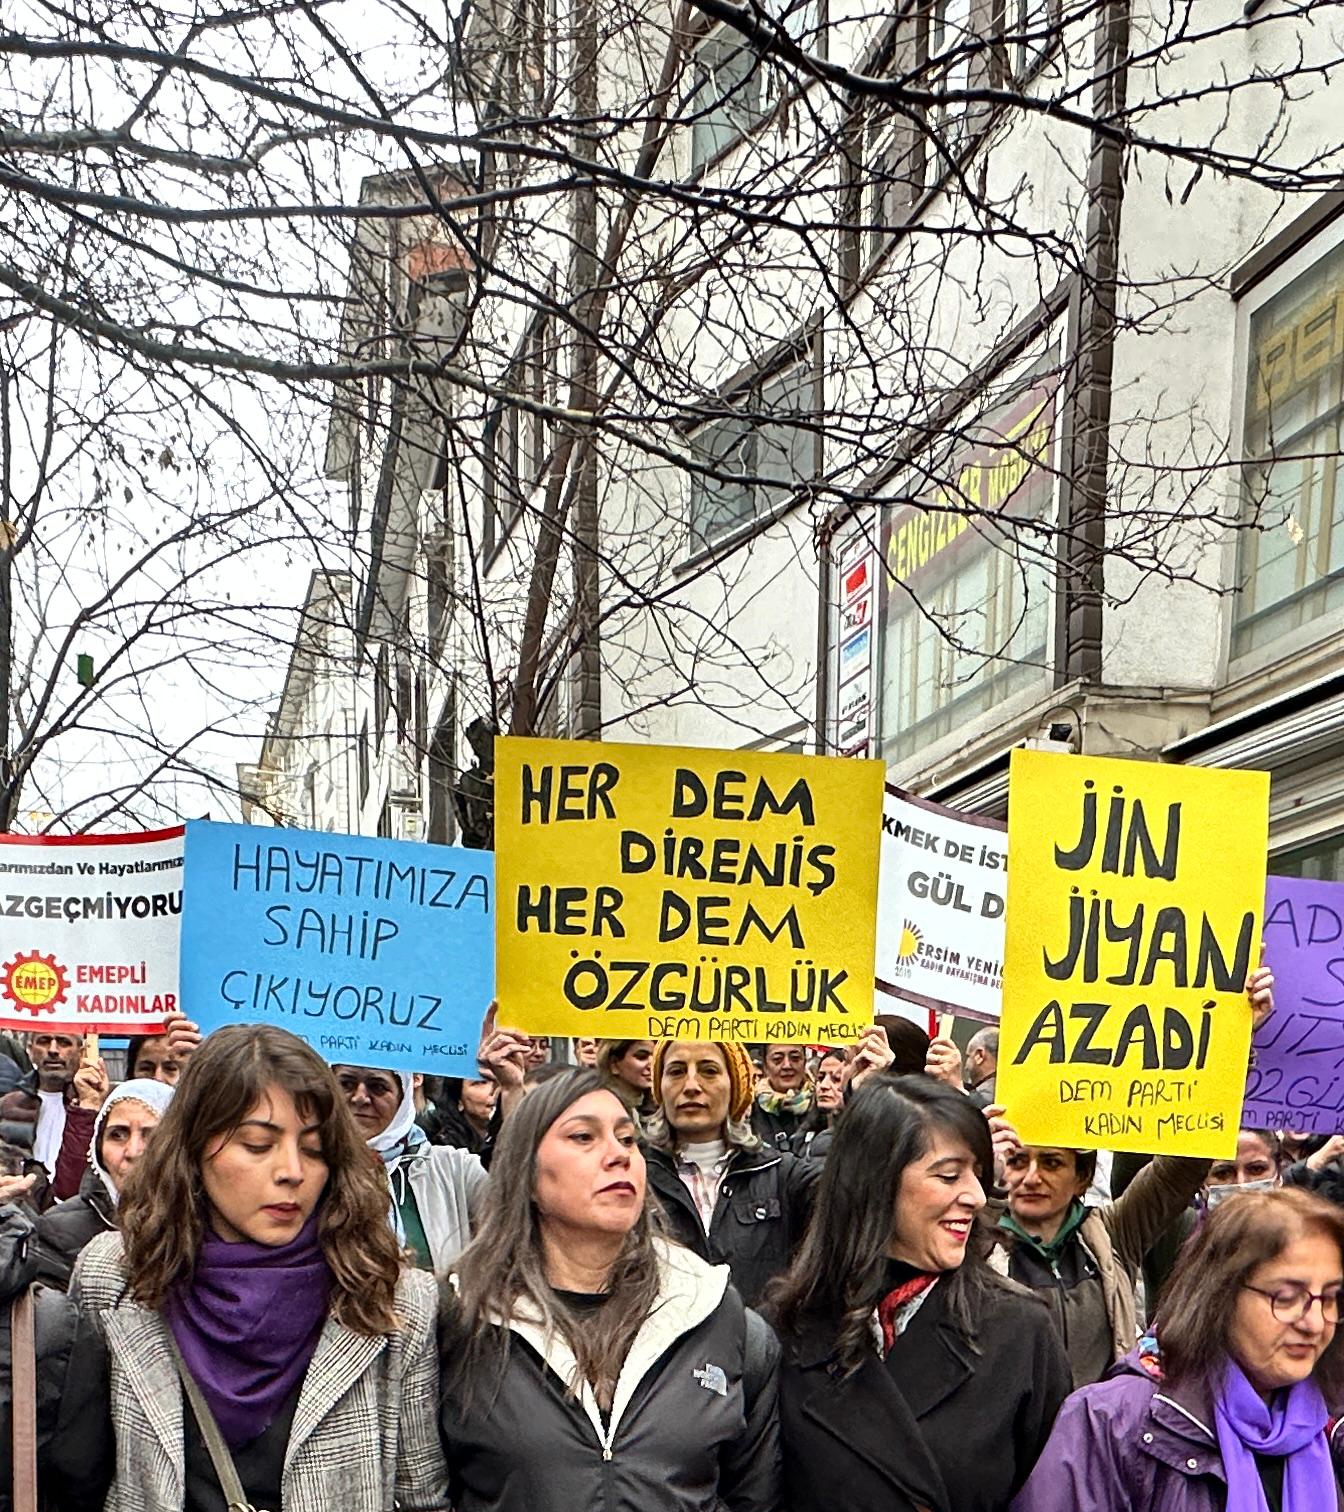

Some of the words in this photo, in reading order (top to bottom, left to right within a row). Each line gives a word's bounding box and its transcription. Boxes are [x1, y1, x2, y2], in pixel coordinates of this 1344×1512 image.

[522, 762, 620, 825] HER
[670, 768, 816, 826] DEM
[76, 862, 96, 875] Ve
[99, 855, 184, 877] Hayatlarımız
[621, 827, 836, 897] DİRENİŞ
[881, 813, 941, 853] KMEK
[944, 840, 975, 864] DE
[979, 845, 1008, 873] İST
[233, 843, 490, 914] HAYATIMIZA
[907, 871, 972, 913] GÜL
[980, 892, 1006, 919] D
[263, 904, 399, 961] SAHİP
[517, 884, 626, 938] HER
[658, 889, 806, 949] DEM
[14, 975, 57, 991] EMEP
[76, 961, 146, 984] EMEPLİ
[563, 949, 850, 1014] ÖZGÜRLÜK
[76, 993, 177, 1014] KADINLAR
[220, 970, 443, 1032] ÇIKIYORUZ
[369, 1039, 412, 1053] KADIN
[648, 1016, 701, 1039] DEM
[766, 1020, 811, 1041] KADIN
[1012, 999, 1217, 1071] AZADİ
[1058, 1079, 1112, 1104] DEM
[1084, 1113, 1143, 1136] KADIN
